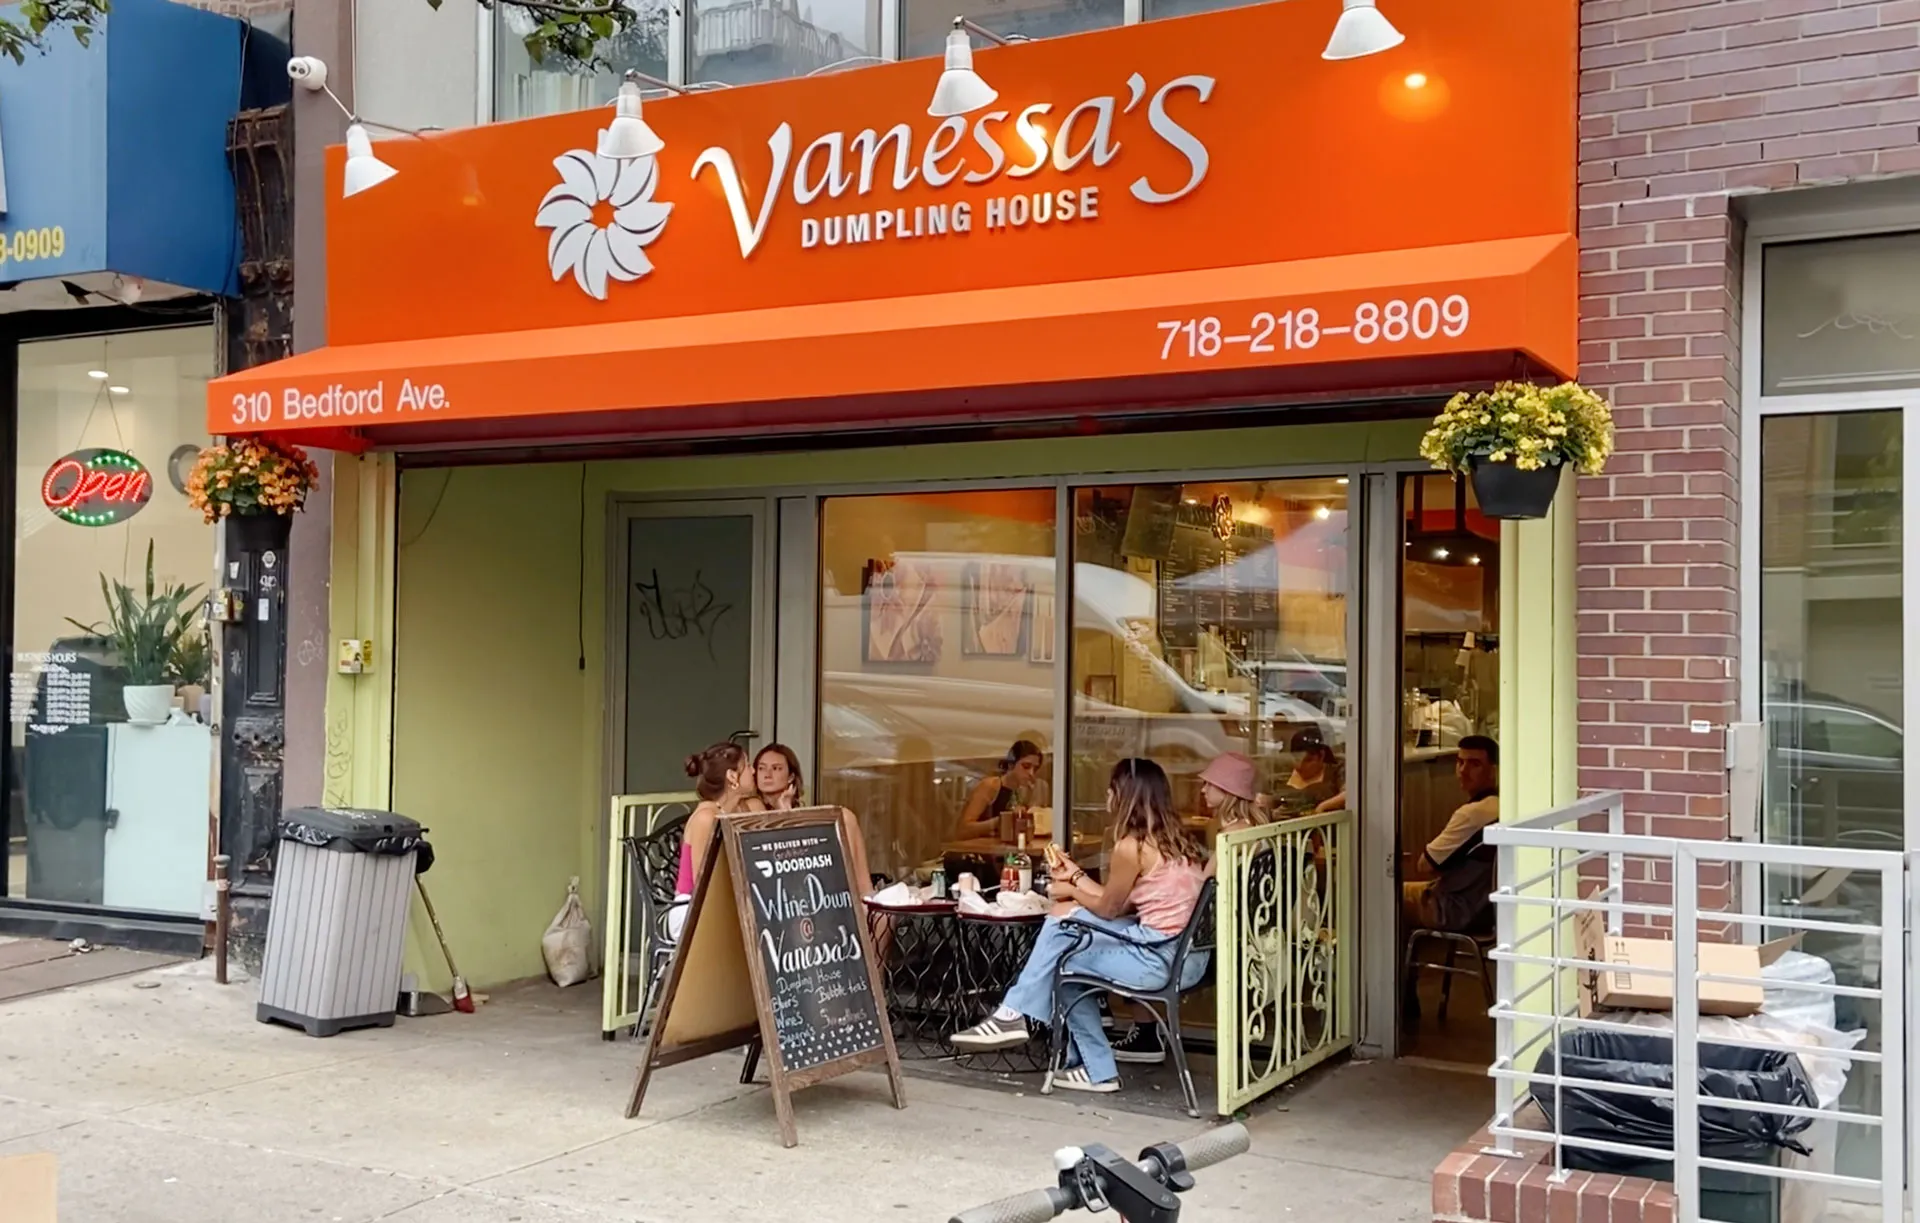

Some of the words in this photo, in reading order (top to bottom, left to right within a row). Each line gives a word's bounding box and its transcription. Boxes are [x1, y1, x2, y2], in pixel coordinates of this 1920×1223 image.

[801, 201, 972, 248] DUMPLING
[985, 186, 1099, 229] HOUSE
[1157, 294, 1469, 360] 718-218-8809
[232, 391, 272, 425] 310
[284, 381, 384, 420] Bedford
[396, 378, 450, 412] Ave.
[44, 460, 148, 509] Open
[762, 843, 773, 851] WE
[774, 840, 801, 850] DELIVER
[801, 837, 819, 847] WITH
[775, 853, 833, 874] DOORDASH
[751, 877, 809, 922] Wine
[804, 873, 853, 915] Down
[760, 925, 862, 974] Vanessa's
[800, 917, 815, 943] @
